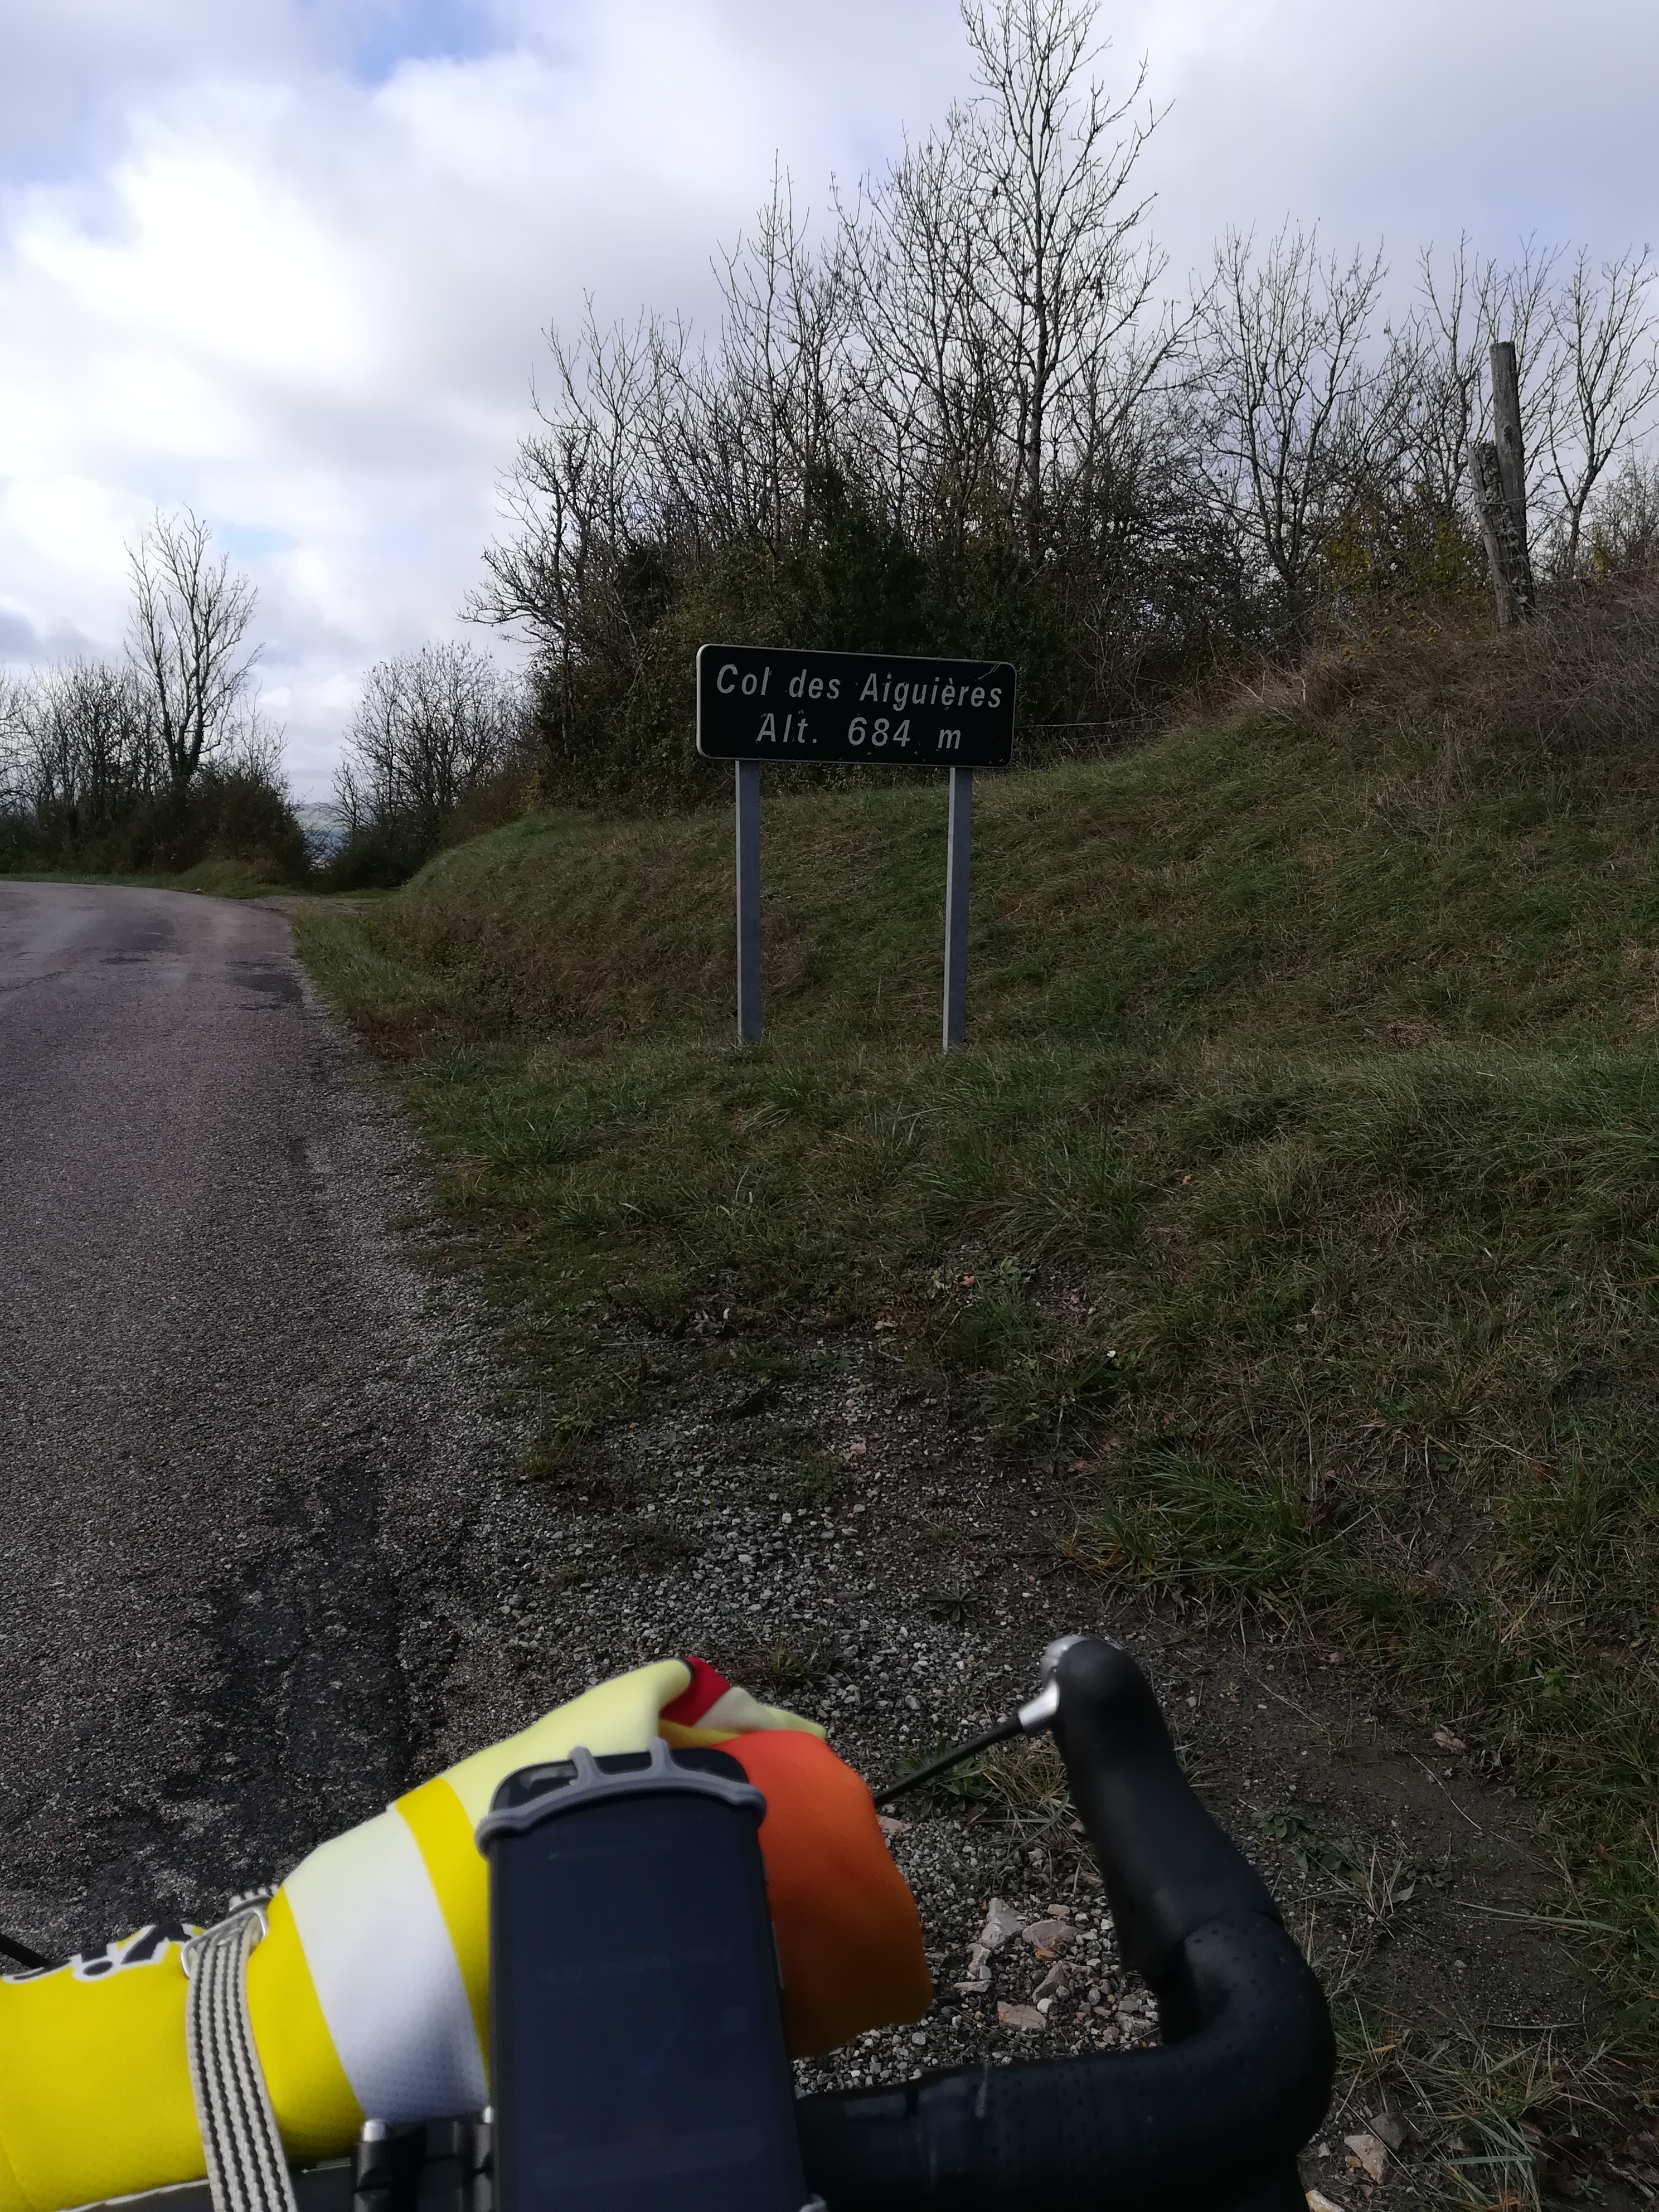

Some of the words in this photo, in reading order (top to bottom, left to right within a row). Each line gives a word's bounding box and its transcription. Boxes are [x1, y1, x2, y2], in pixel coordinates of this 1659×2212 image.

[717, 664, 770, 696] Col
[789, 669, 840, 700] des
[859, 672, 1002, 712] Aiguières
[756, 714, 817, 744] Alt.
[848, 717, 910, 747] 684
[938, 728, 962, 749] m
